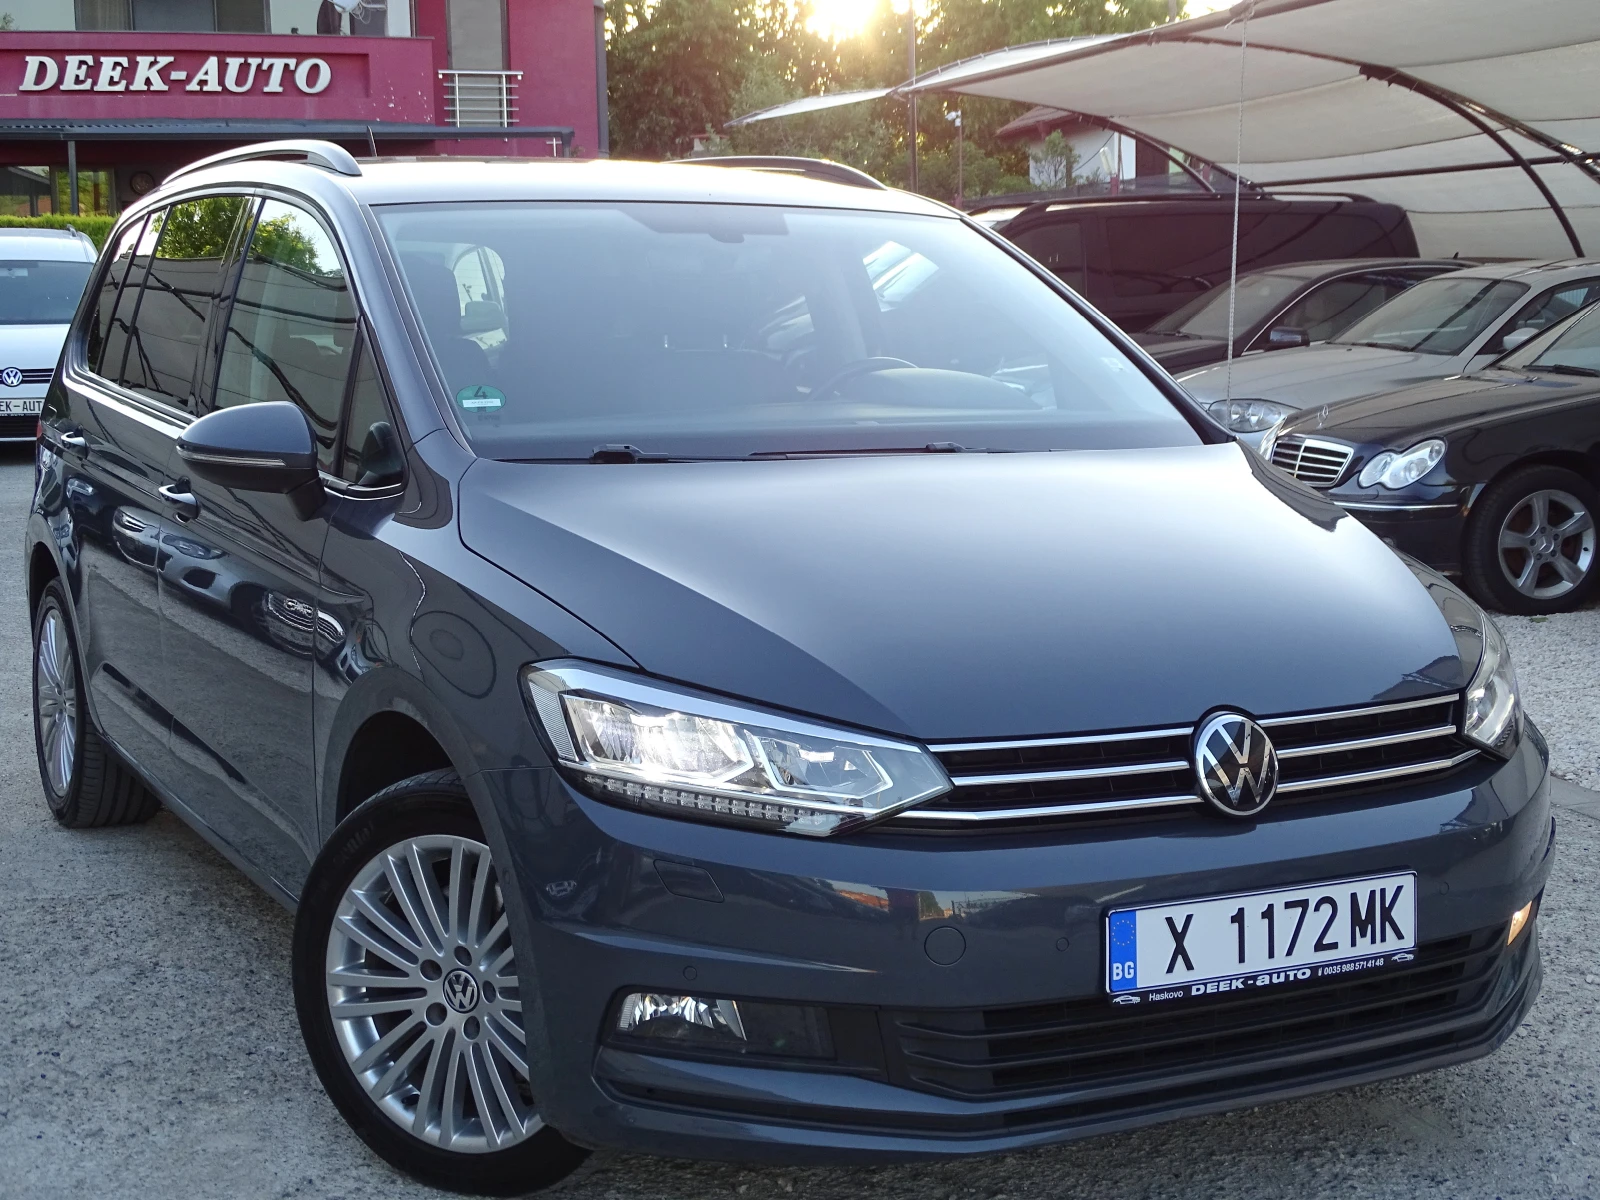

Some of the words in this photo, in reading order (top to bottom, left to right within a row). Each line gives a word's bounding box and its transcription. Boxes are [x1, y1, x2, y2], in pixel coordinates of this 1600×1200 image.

[19, 55, 332, 94] DEEK-AUTO
[1165, 913, 1195, 974] X
[1112, 961, 1135, 981] BG
[1148, 990, 1184, 1002] Haskovo
